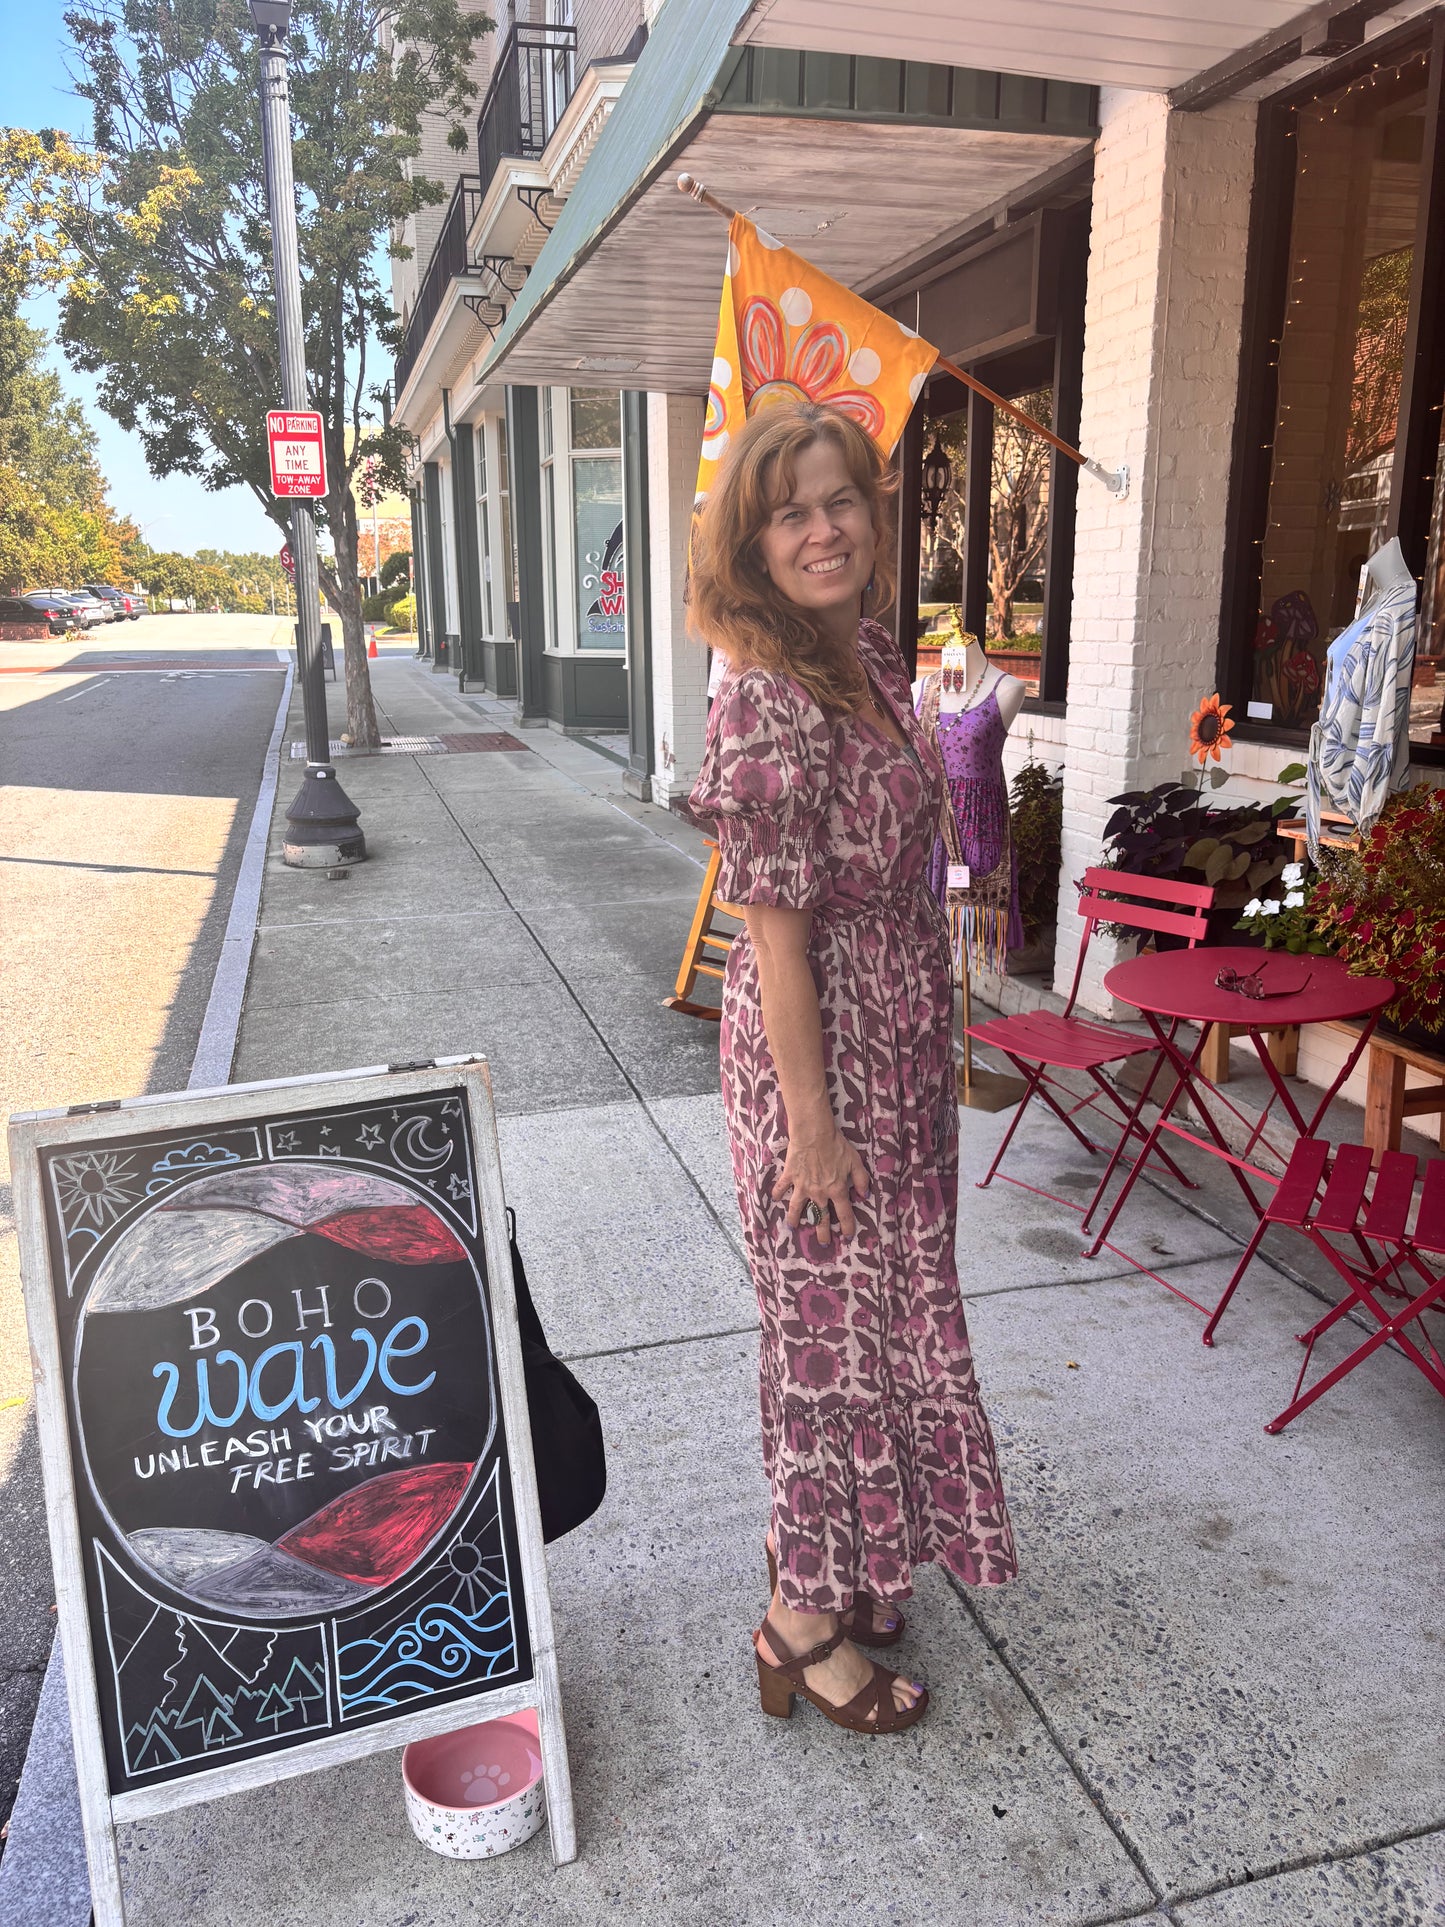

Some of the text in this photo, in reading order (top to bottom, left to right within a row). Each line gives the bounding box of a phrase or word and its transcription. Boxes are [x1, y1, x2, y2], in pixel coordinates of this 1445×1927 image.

[269, 417, 317, 433] NO PARKING
[285, 445, 306, 456] ANY
[285, 460, 309, 470] TIME
[276, 475, 321, 485] TOW-AWAY
[288, 485, 311, 494] ZONE
[184, 1278, 392, 1350] BOHO
[153, 1316, 437, 1438] wave
[134, 1405, 397, 1479] UNLEASH YOUR
[229, 1429, 437, 1494] FREE SPIRIT
